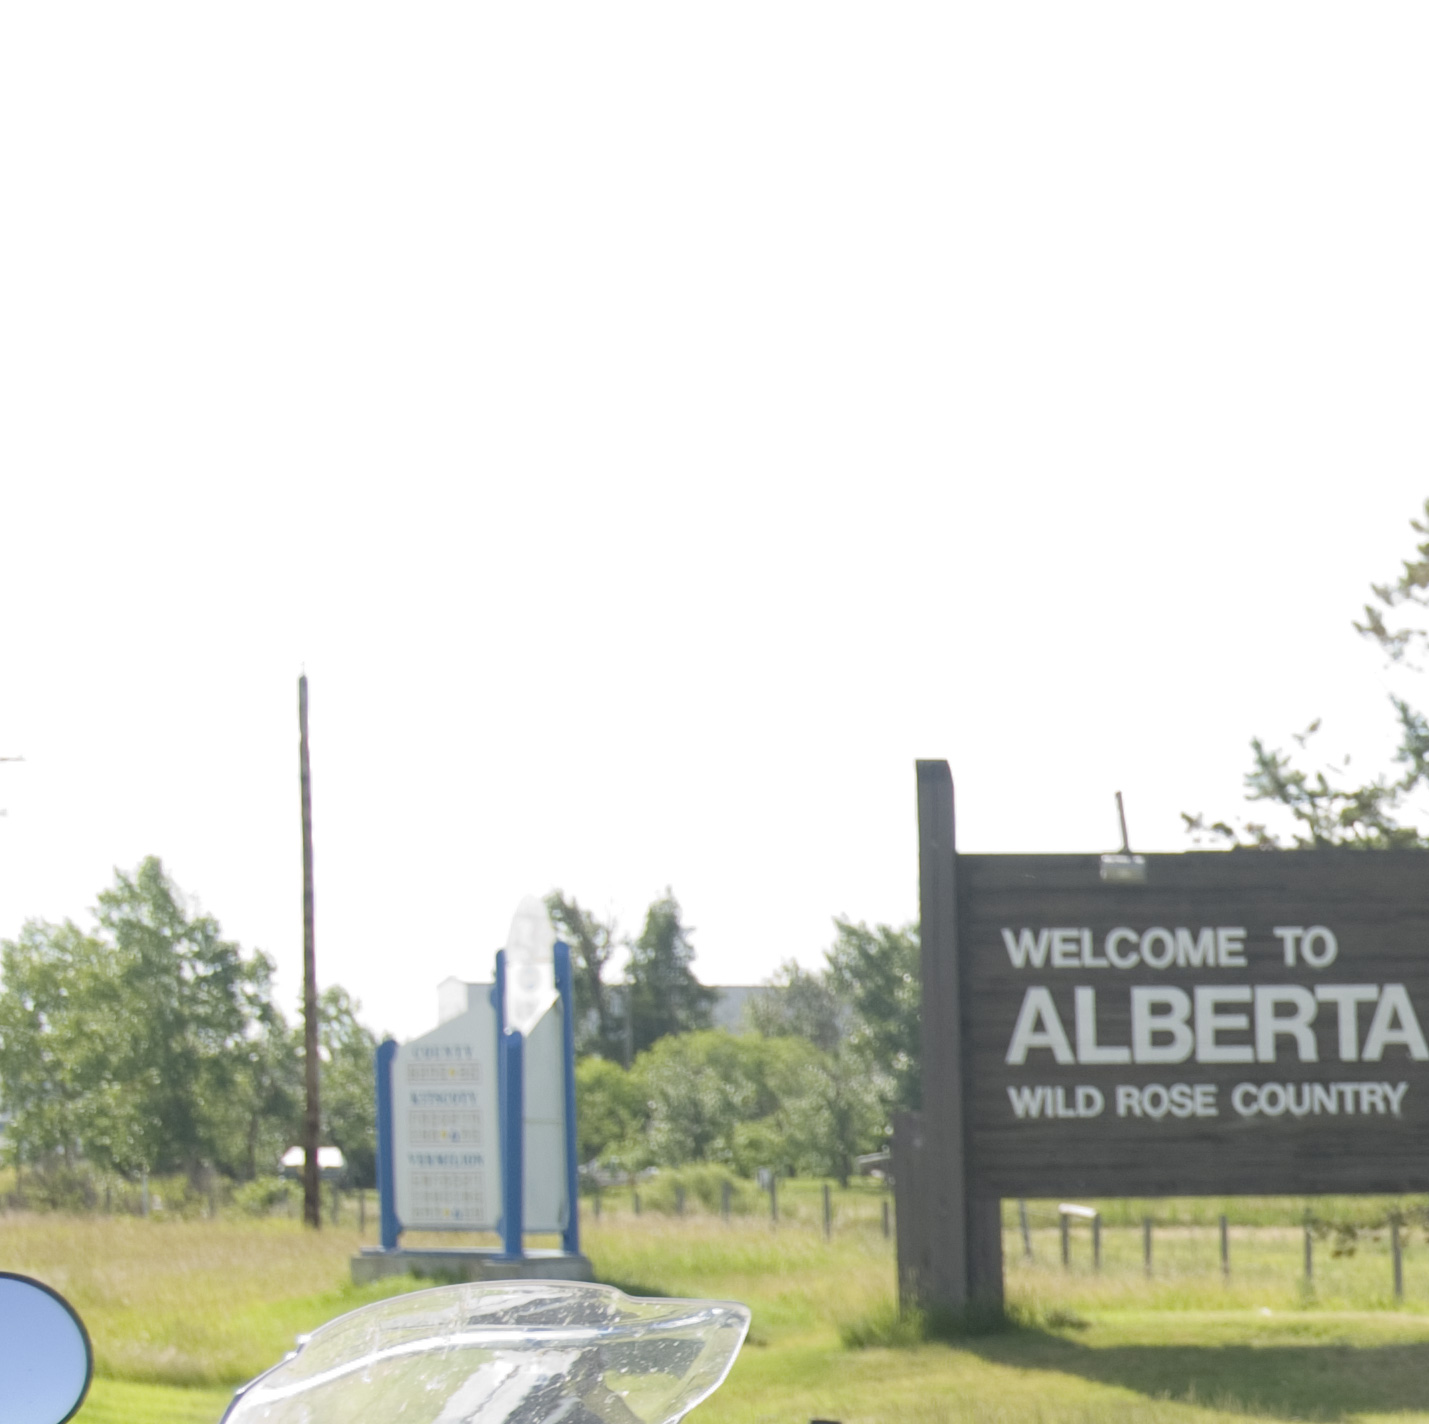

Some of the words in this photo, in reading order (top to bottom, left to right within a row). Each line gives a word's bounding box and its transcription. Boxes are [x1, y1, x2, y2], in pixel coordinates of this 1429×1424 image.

[1001, 926, 1247, 969] WELCOME
[1273, 925, 1338, 968] TO
[1006, 1085, 1105, 1119] WILD
[1115, 1082, 1219, 1119] ROSE
[1231, 1081, 1409, 1118] COUNTRY
